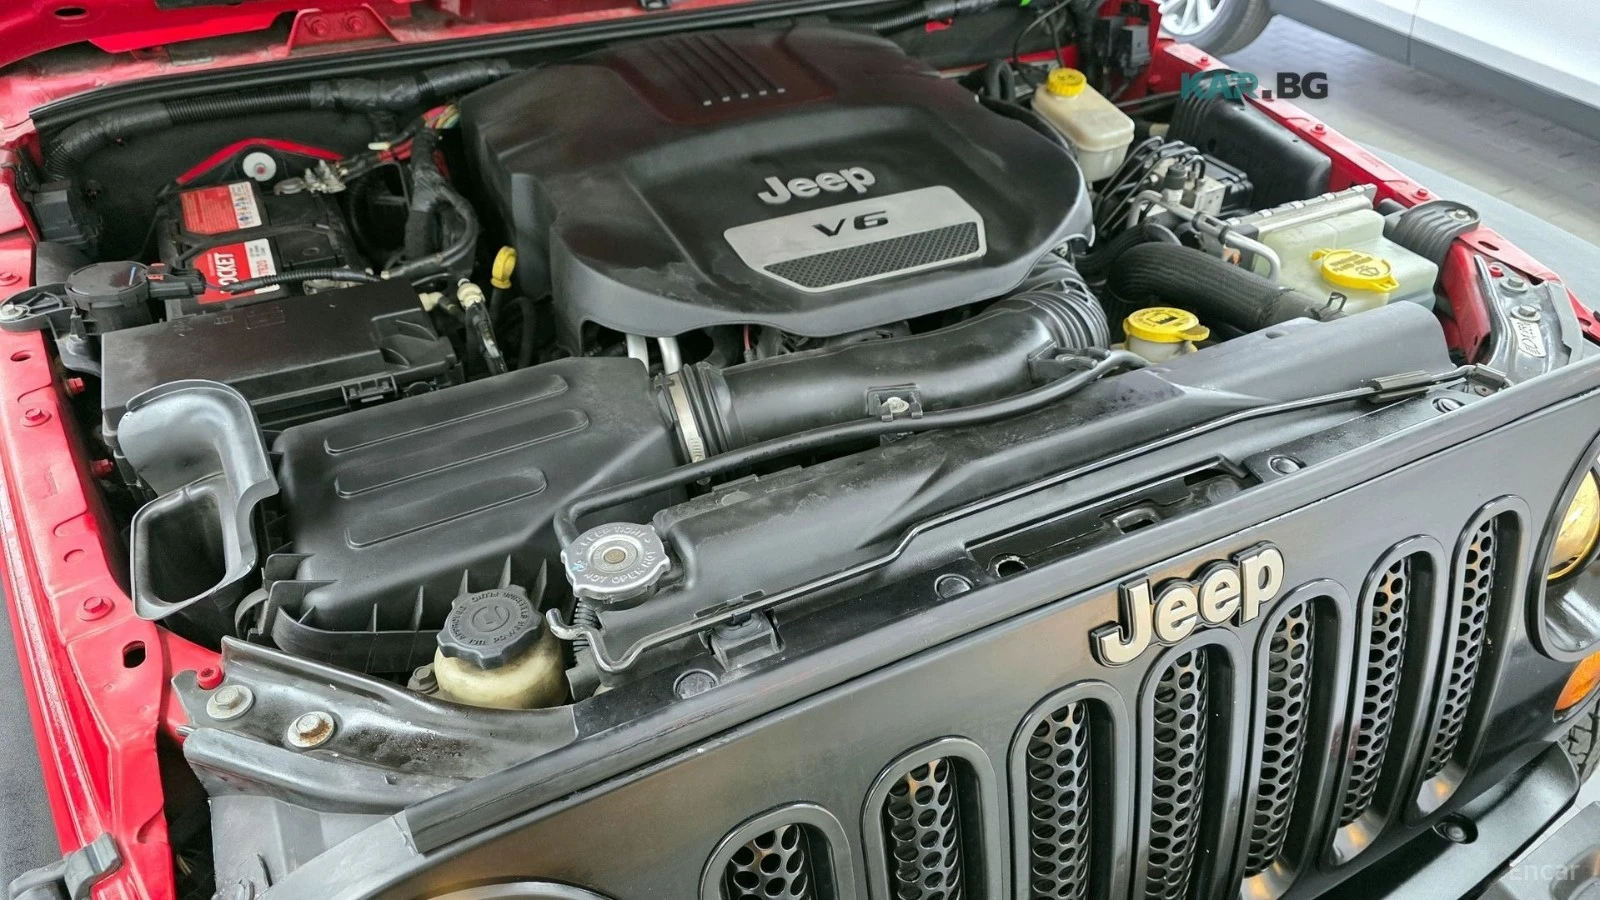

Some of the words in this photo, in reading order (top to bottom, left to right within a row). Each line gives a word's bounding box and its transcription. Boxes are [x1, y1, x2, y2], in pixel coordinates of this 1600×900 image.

[757, 166, 876, 204] Jeep
[812, 210, 889, 237] V6
[214, 252, 239, 294] OCKET
[1093, 542, 1284, 667] Jeep
